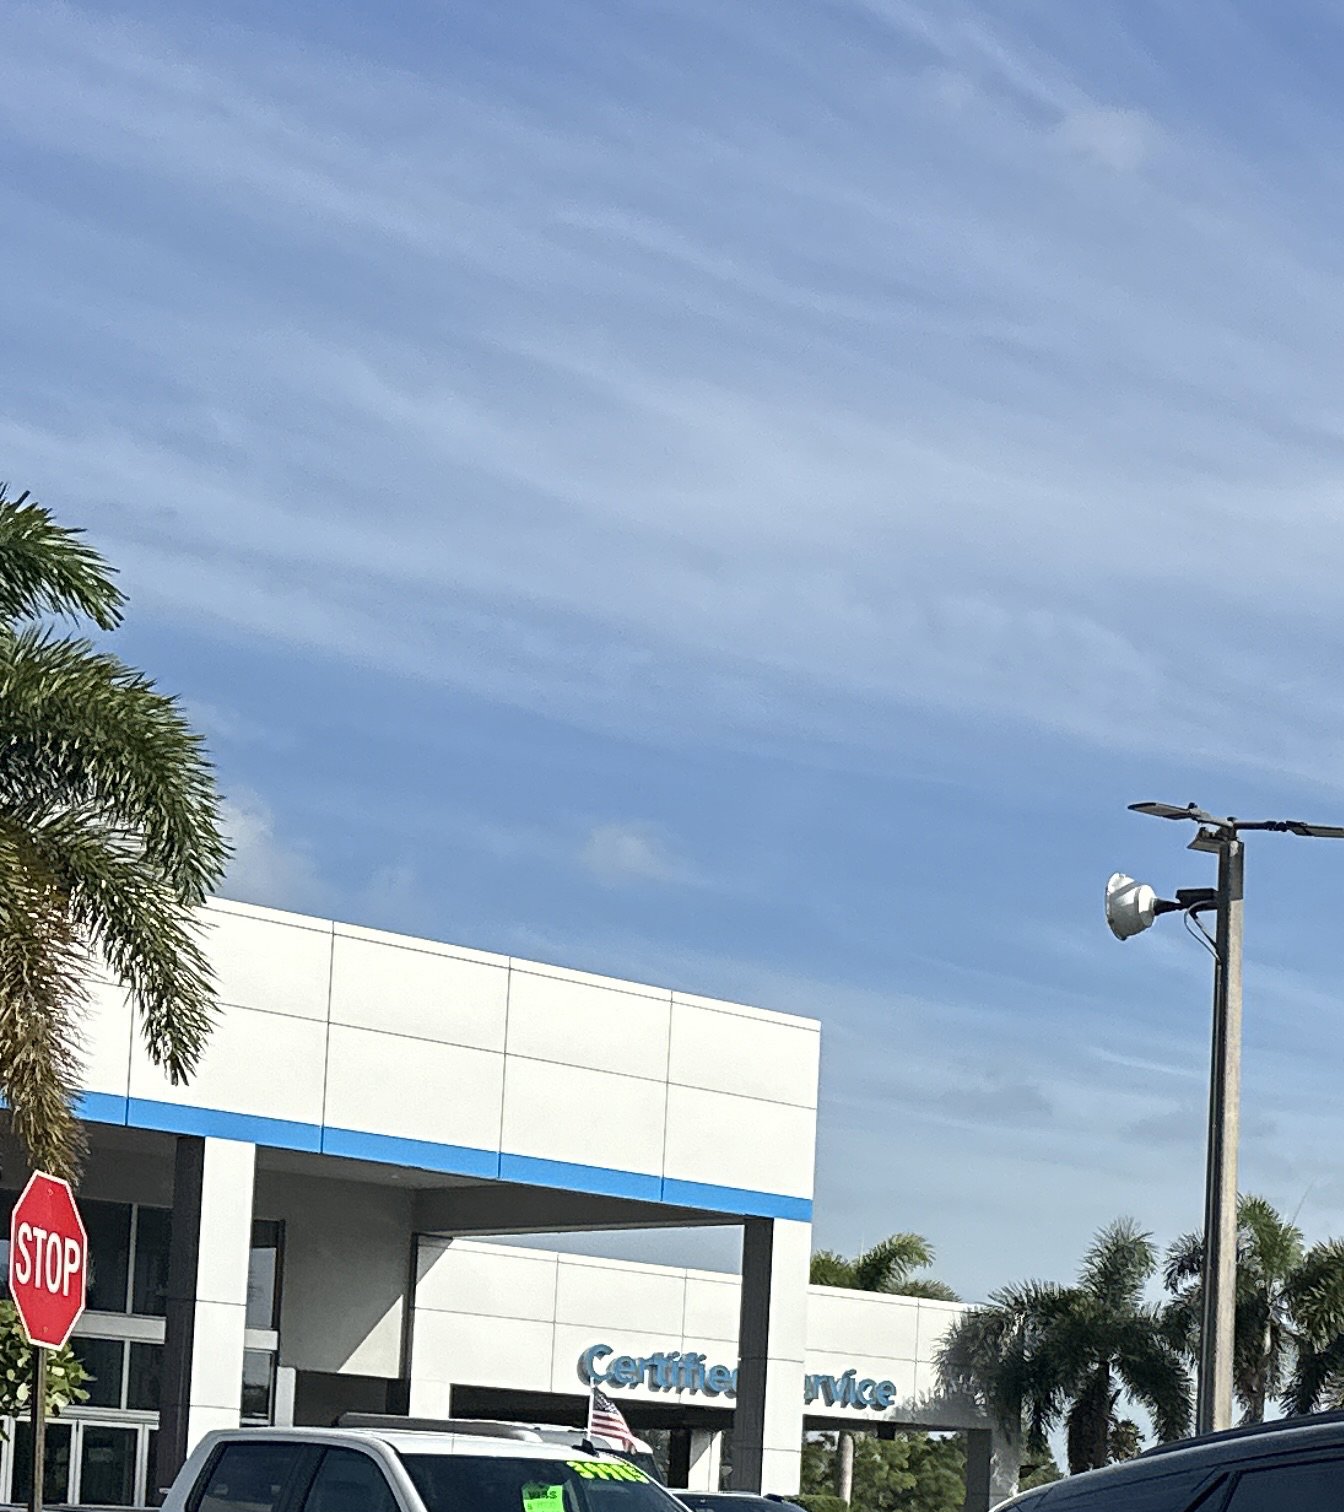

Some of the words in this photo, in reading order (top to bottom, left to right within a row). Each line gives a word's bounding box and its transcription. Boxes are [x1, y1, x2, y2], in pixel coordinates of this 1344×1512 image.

[15, 1222, 81, 1297] STOP
[579, 1344, 738, 1398] Certifie
[804, 1369, 897, 1409] rvice
